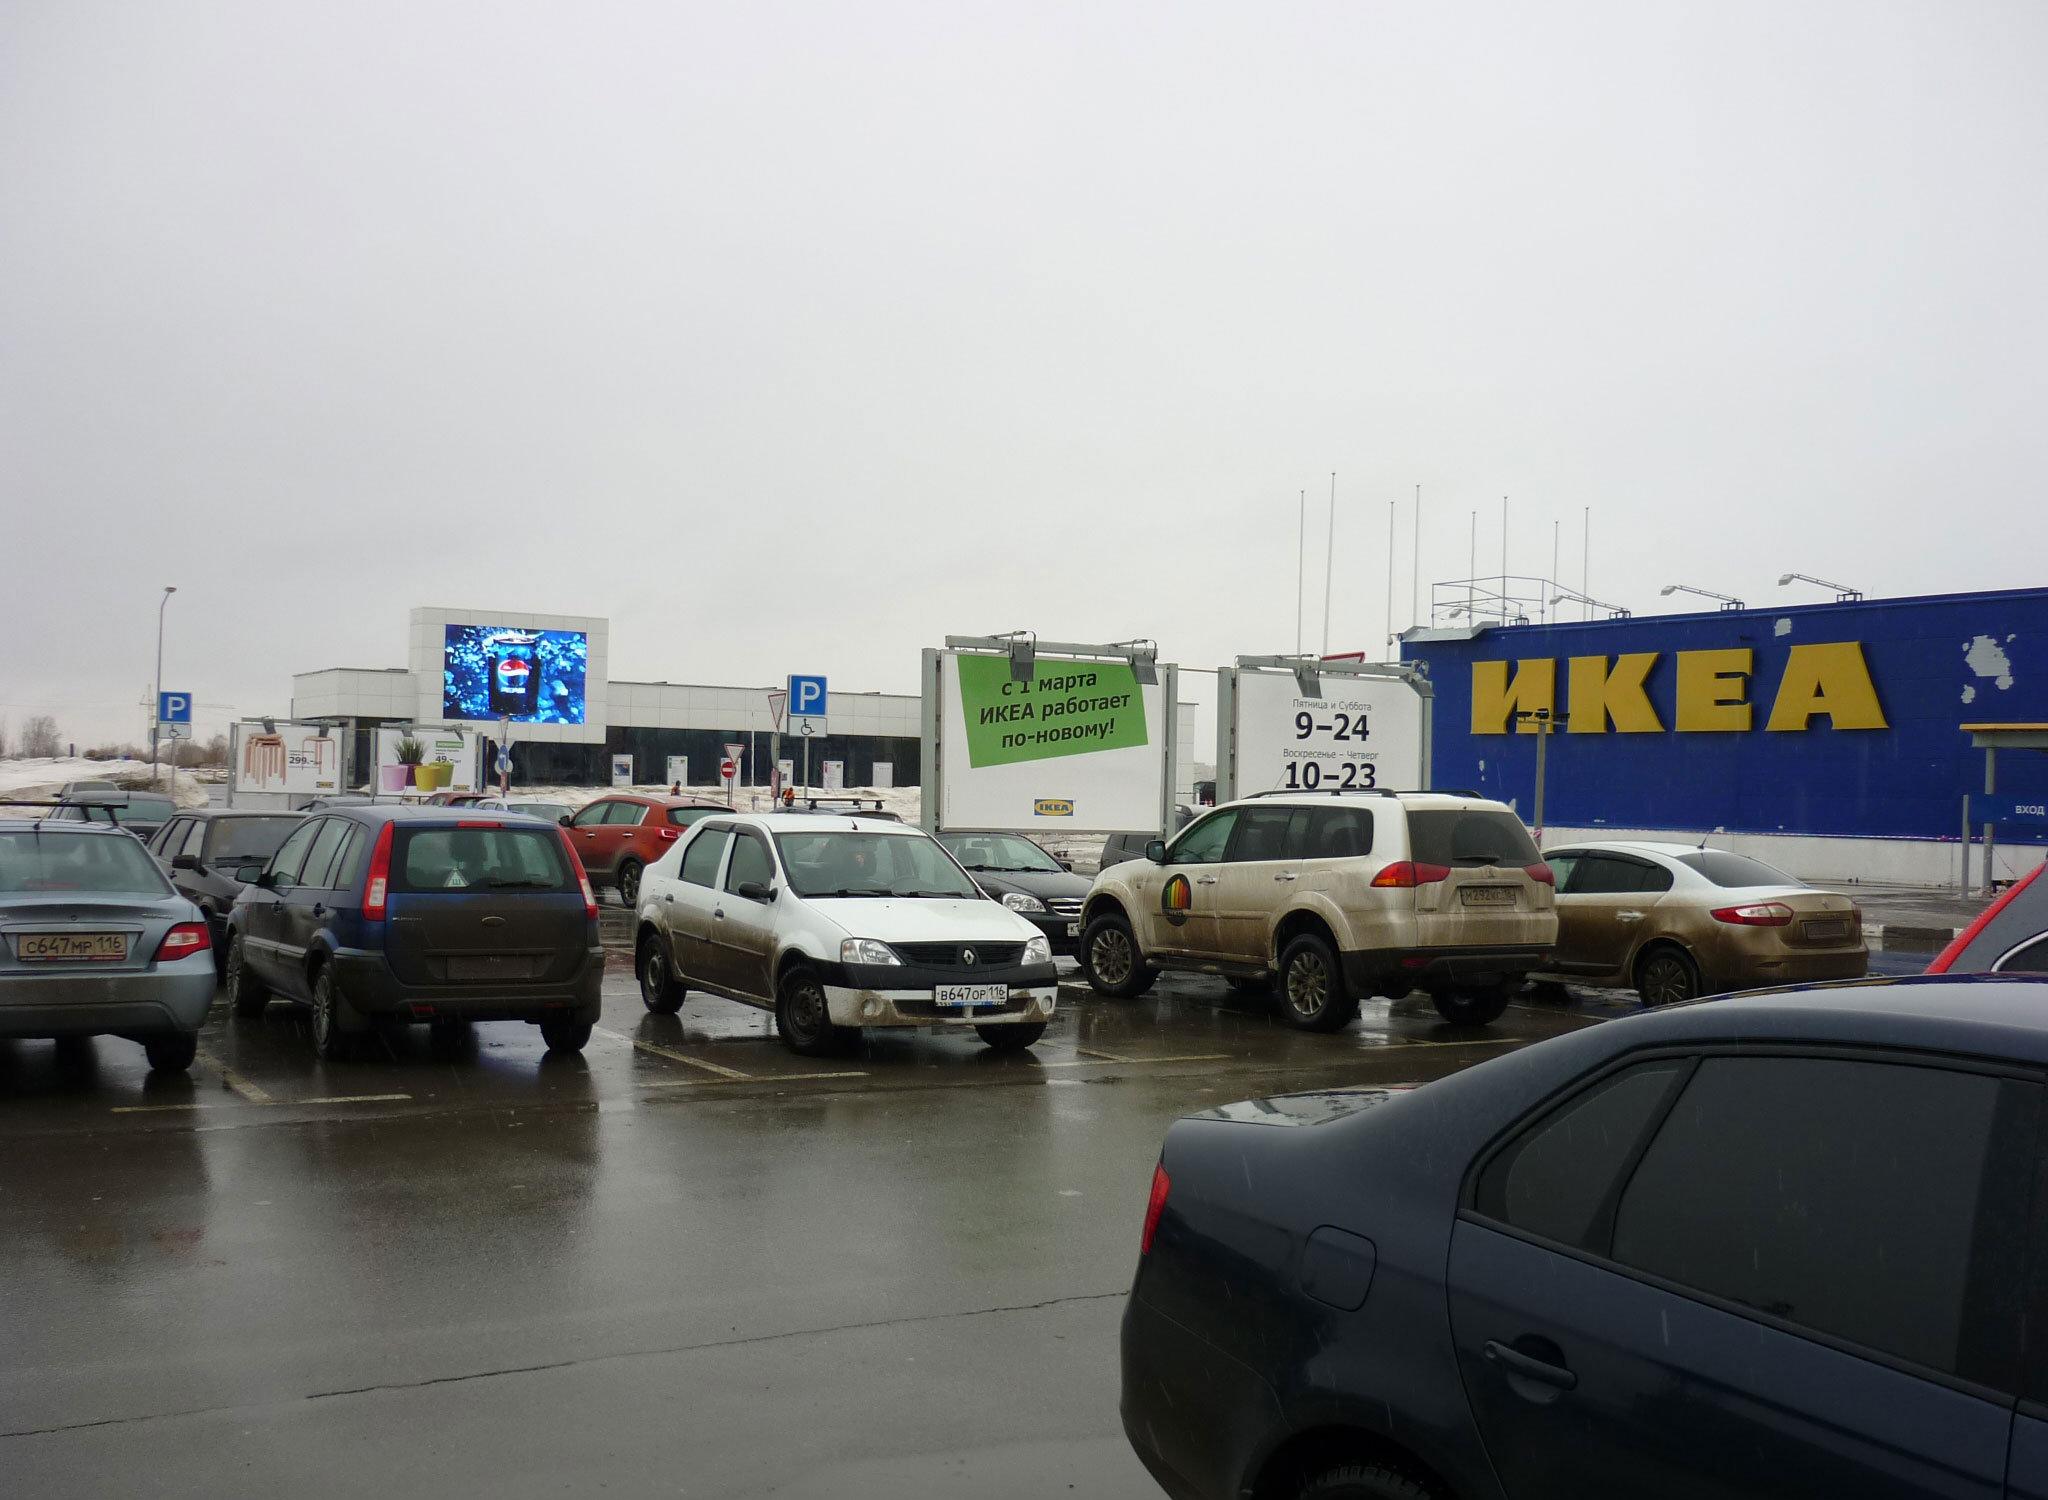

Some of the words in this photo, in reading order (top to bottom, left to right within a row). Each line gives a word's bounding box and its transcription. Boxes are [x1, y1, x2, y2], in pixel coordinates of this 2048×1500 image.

[1001, 682, 1013, 696] с
[1038, 672, 1097, 694] марта
[1470, 641, 1889, 735] ИКЕА
[167, 696, 186, 719] P
[800, 681, 821, 711] P
[1292, 699, 1328, 710] Пятница
[1338, 700, 1372, 712] Суббота
[979, 702, 1035, 725] ИКЕА
[1041, 693, 1131, 721] работает
[1001, 717, 1115, 749] по-новому!
[1283, 748, 1337, 760] Воскресенье
[1346, 750, 1379, 761] Четверг
[1039, 803, 1070, 812] IKEA
[2015, 805, 2045, 816] ВХОД
